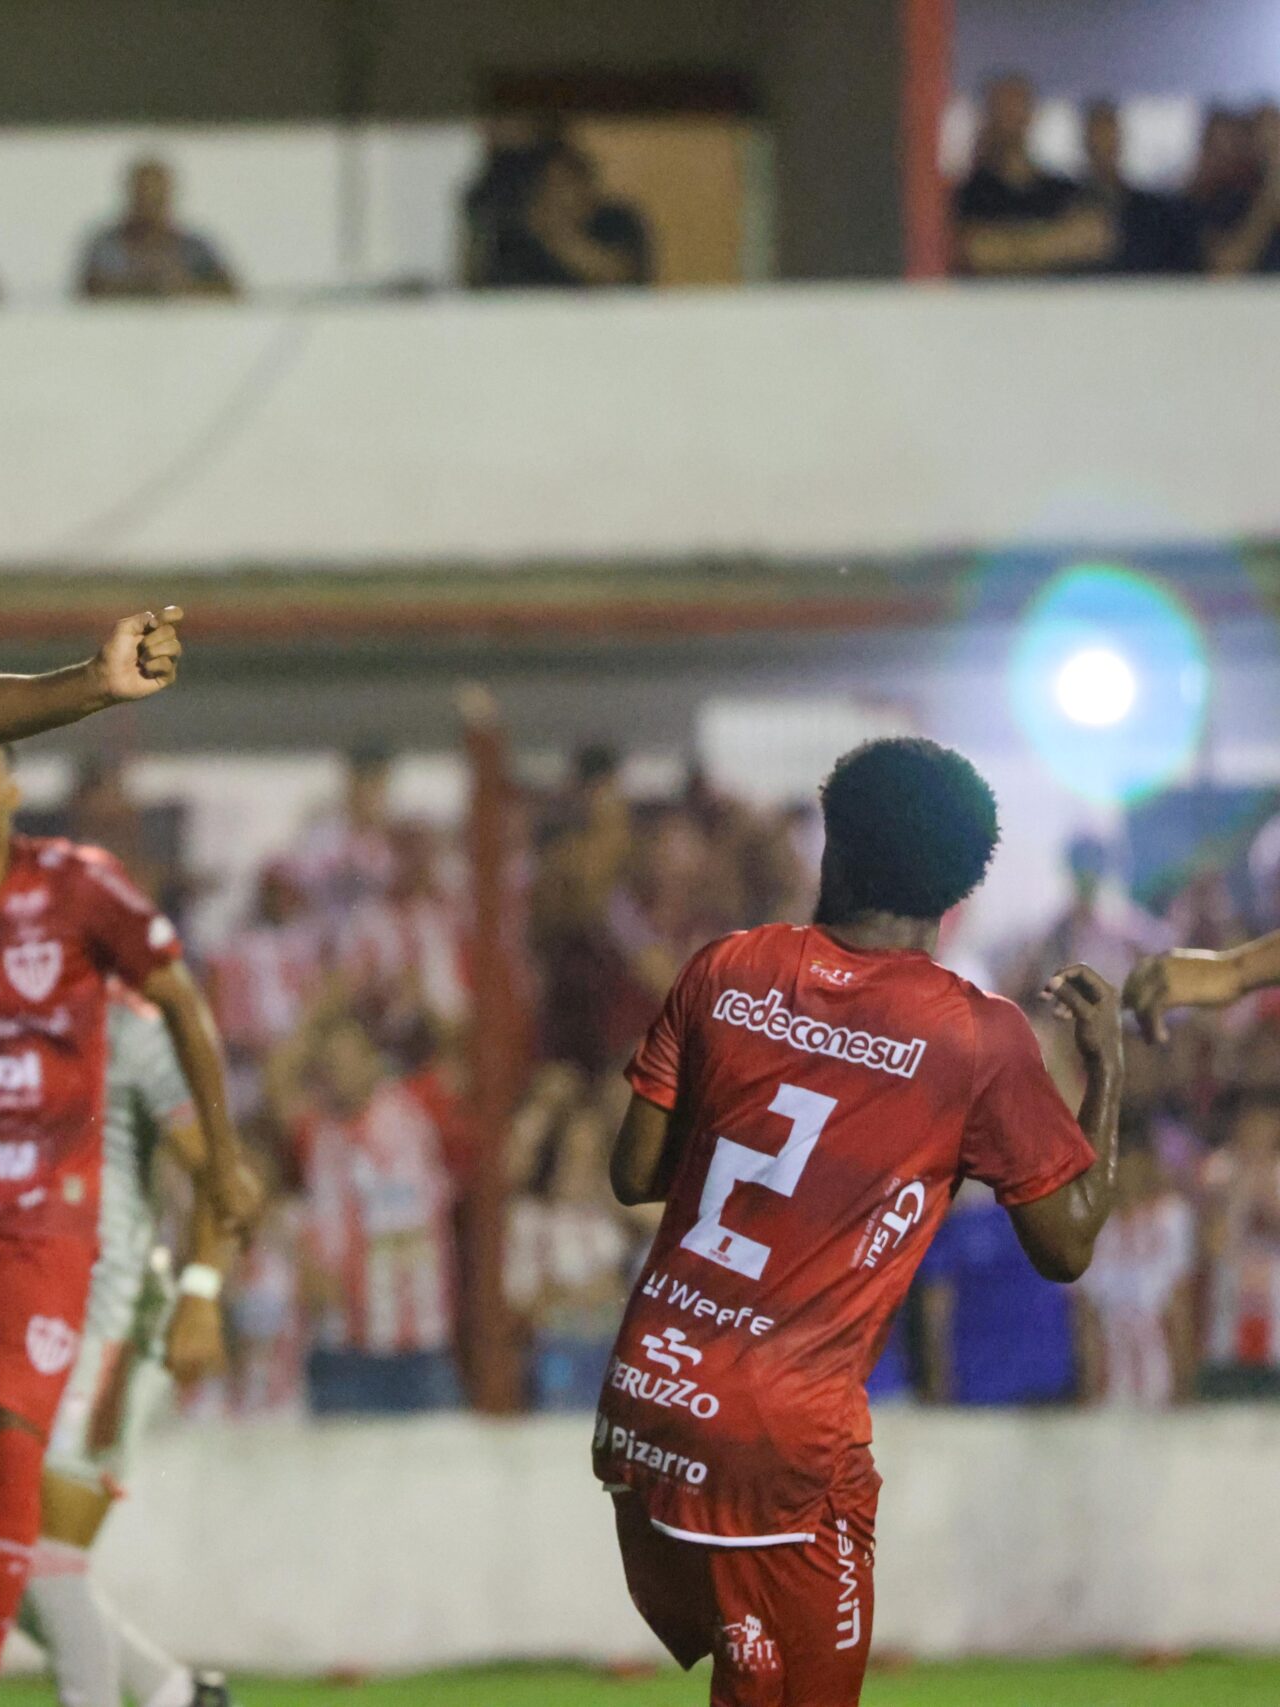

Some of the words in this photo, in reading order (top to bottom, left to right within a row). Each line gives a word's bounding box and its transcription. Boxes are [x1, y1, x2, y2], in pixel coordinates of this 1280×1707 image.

[712, 988, 927, 1079] redeconesul
[680, 1083, 839, 1281] 2
[611, 1426, 708, 1485] Pizarro
